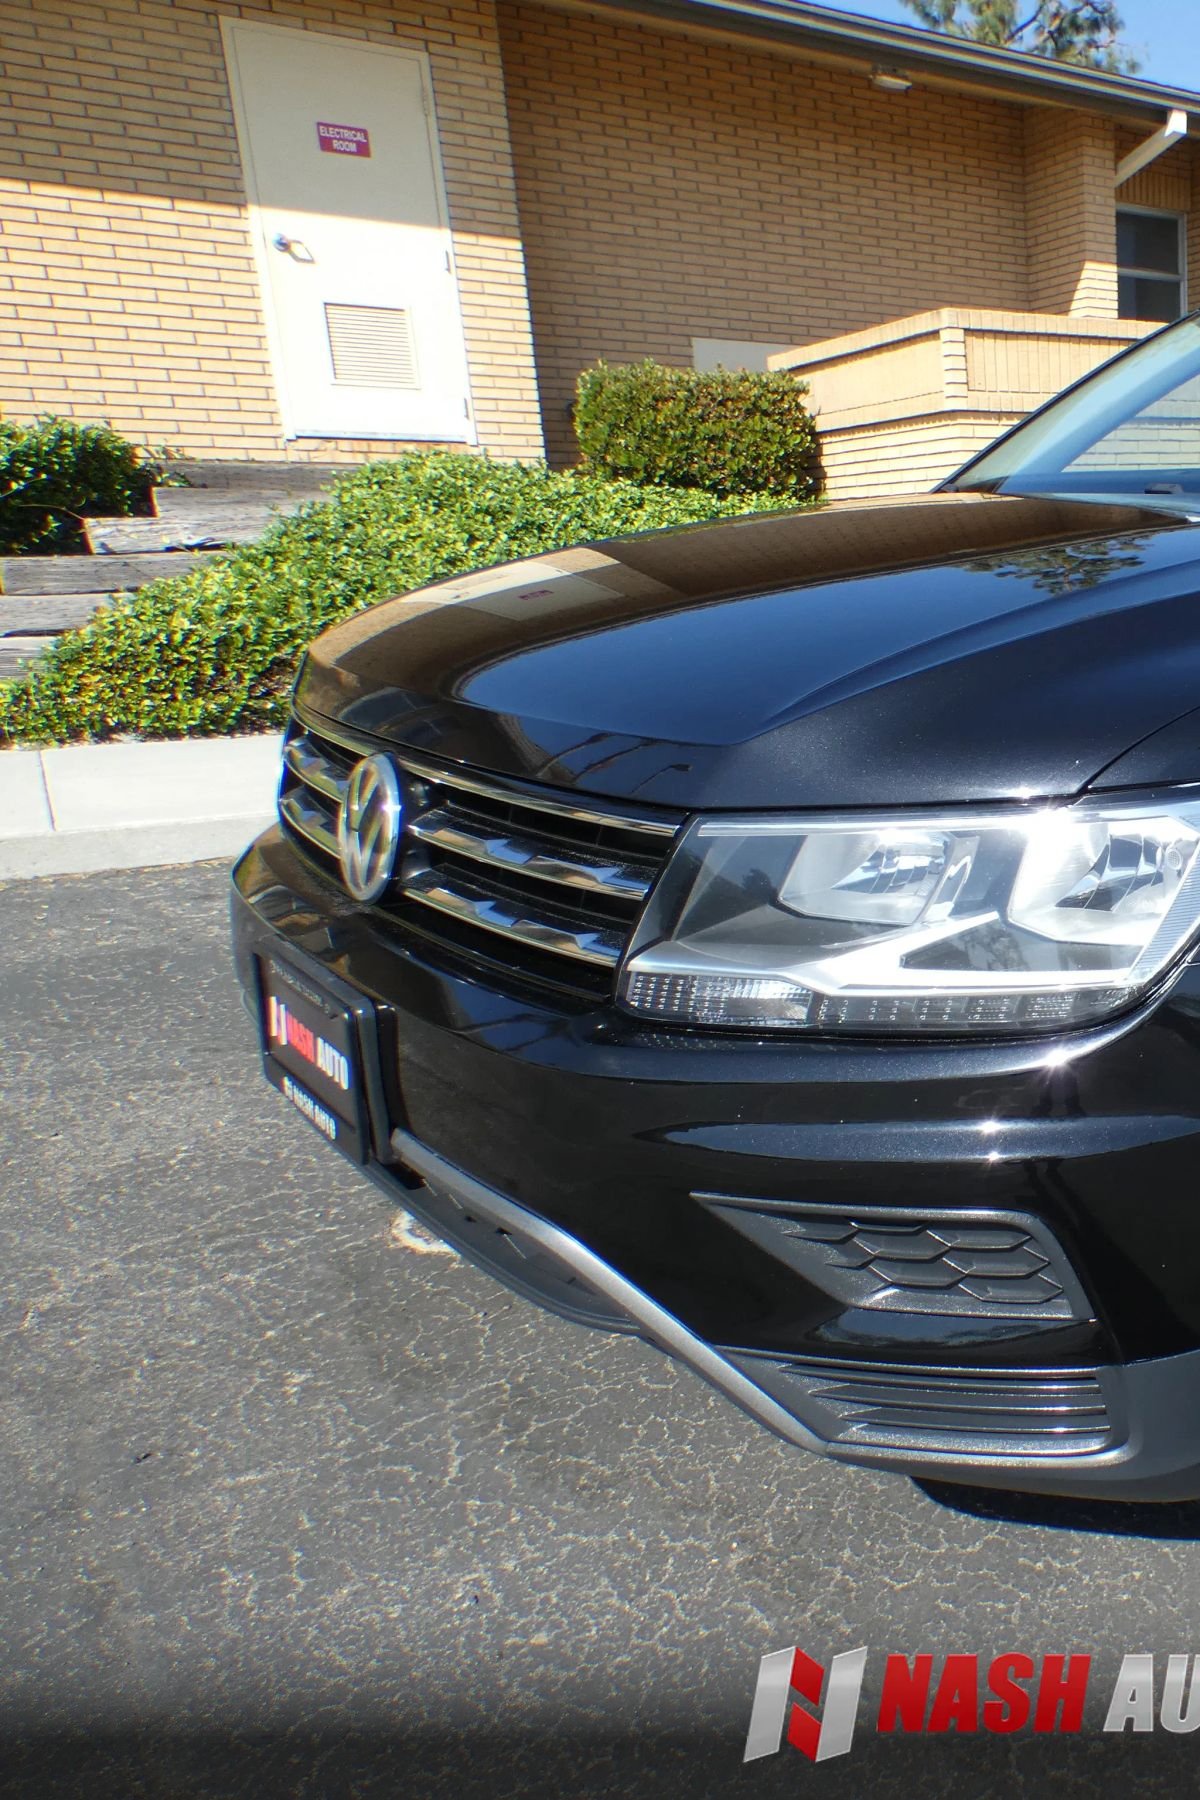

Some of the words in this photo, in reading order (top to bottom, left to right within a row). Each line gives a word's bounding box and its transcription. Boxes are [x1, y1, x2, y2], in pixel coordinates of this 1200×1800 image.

[319, 125, 367, 142] ELECTRICAL
[332, 139, 358, 153] ROOM
[316, 1036, 349, 1091] AUTO
